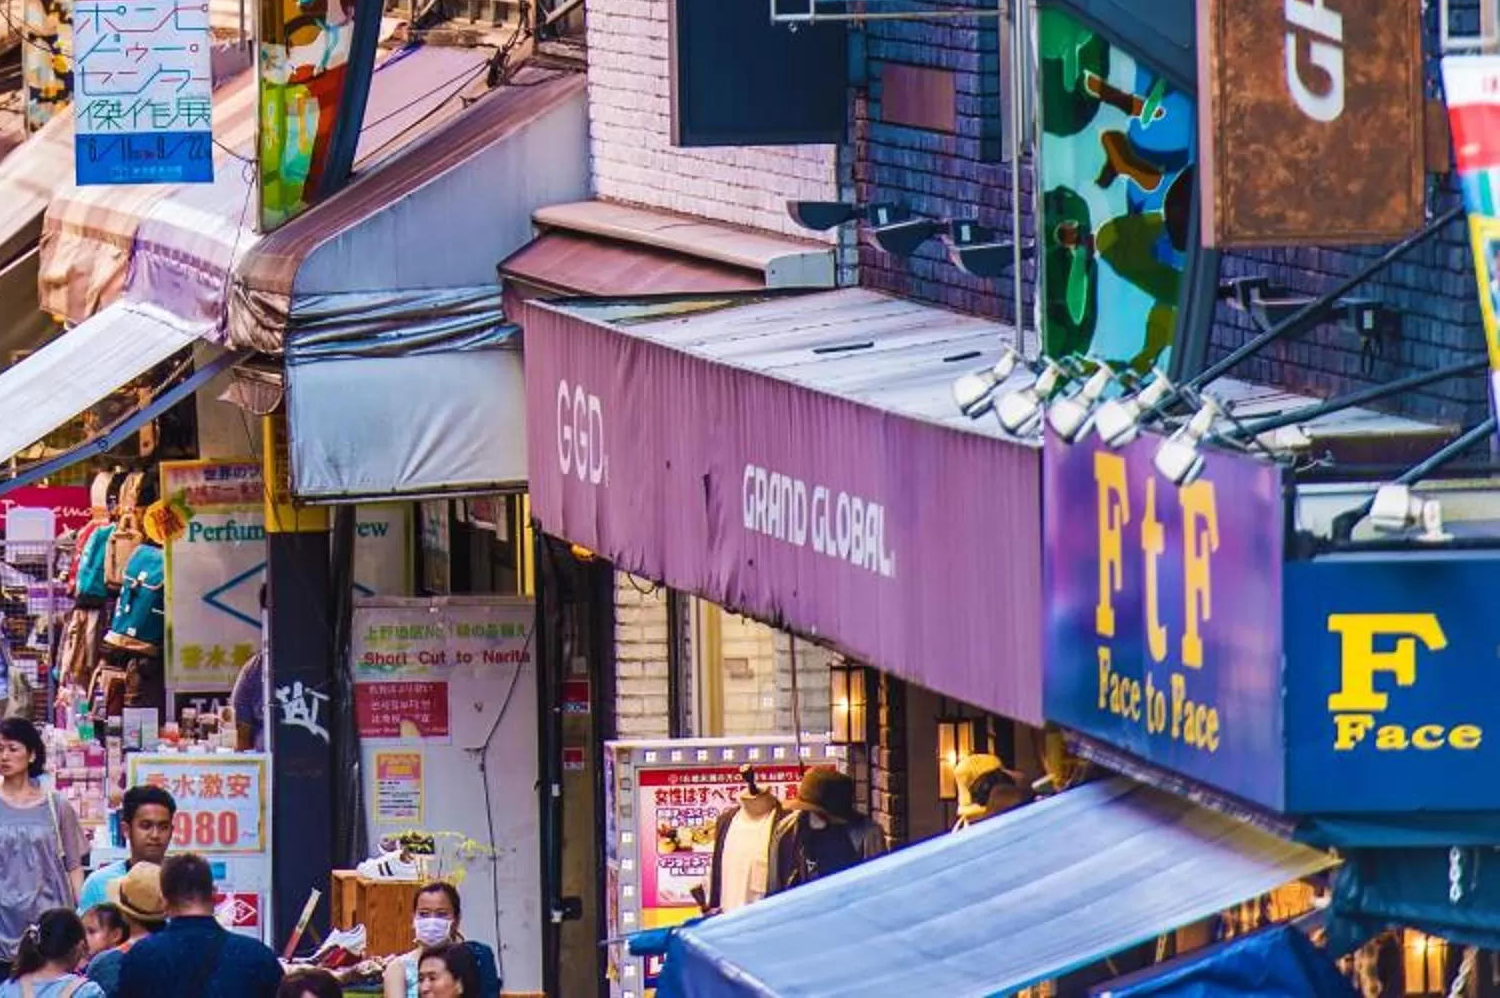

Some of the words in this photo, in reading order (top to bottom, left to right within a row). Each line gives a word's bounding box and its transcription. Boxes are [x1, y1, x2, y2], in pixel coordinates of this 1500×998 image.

[77, 97, 212, 130] 傑作展
[556, 379, 604, 485] GGD
[742, 463, 808, 546] GRAND
[811, 484, 893, 578] GLOBAL
[1093, 450, 1220, 669] FtF
[363, 651, 407, 667] Short
[418, 650, 446, 666] Cut
[456, 651, 473, 665] to
[483, 649, 532, 665] Narita
[1097, 646, 1141, 720] Face
[1145, 671, 1167, 733] to
[1170, 673, 1221, 754] Face
[1327, 612, 1448, 712] F
[1332, 713, 1484, 751] Face
